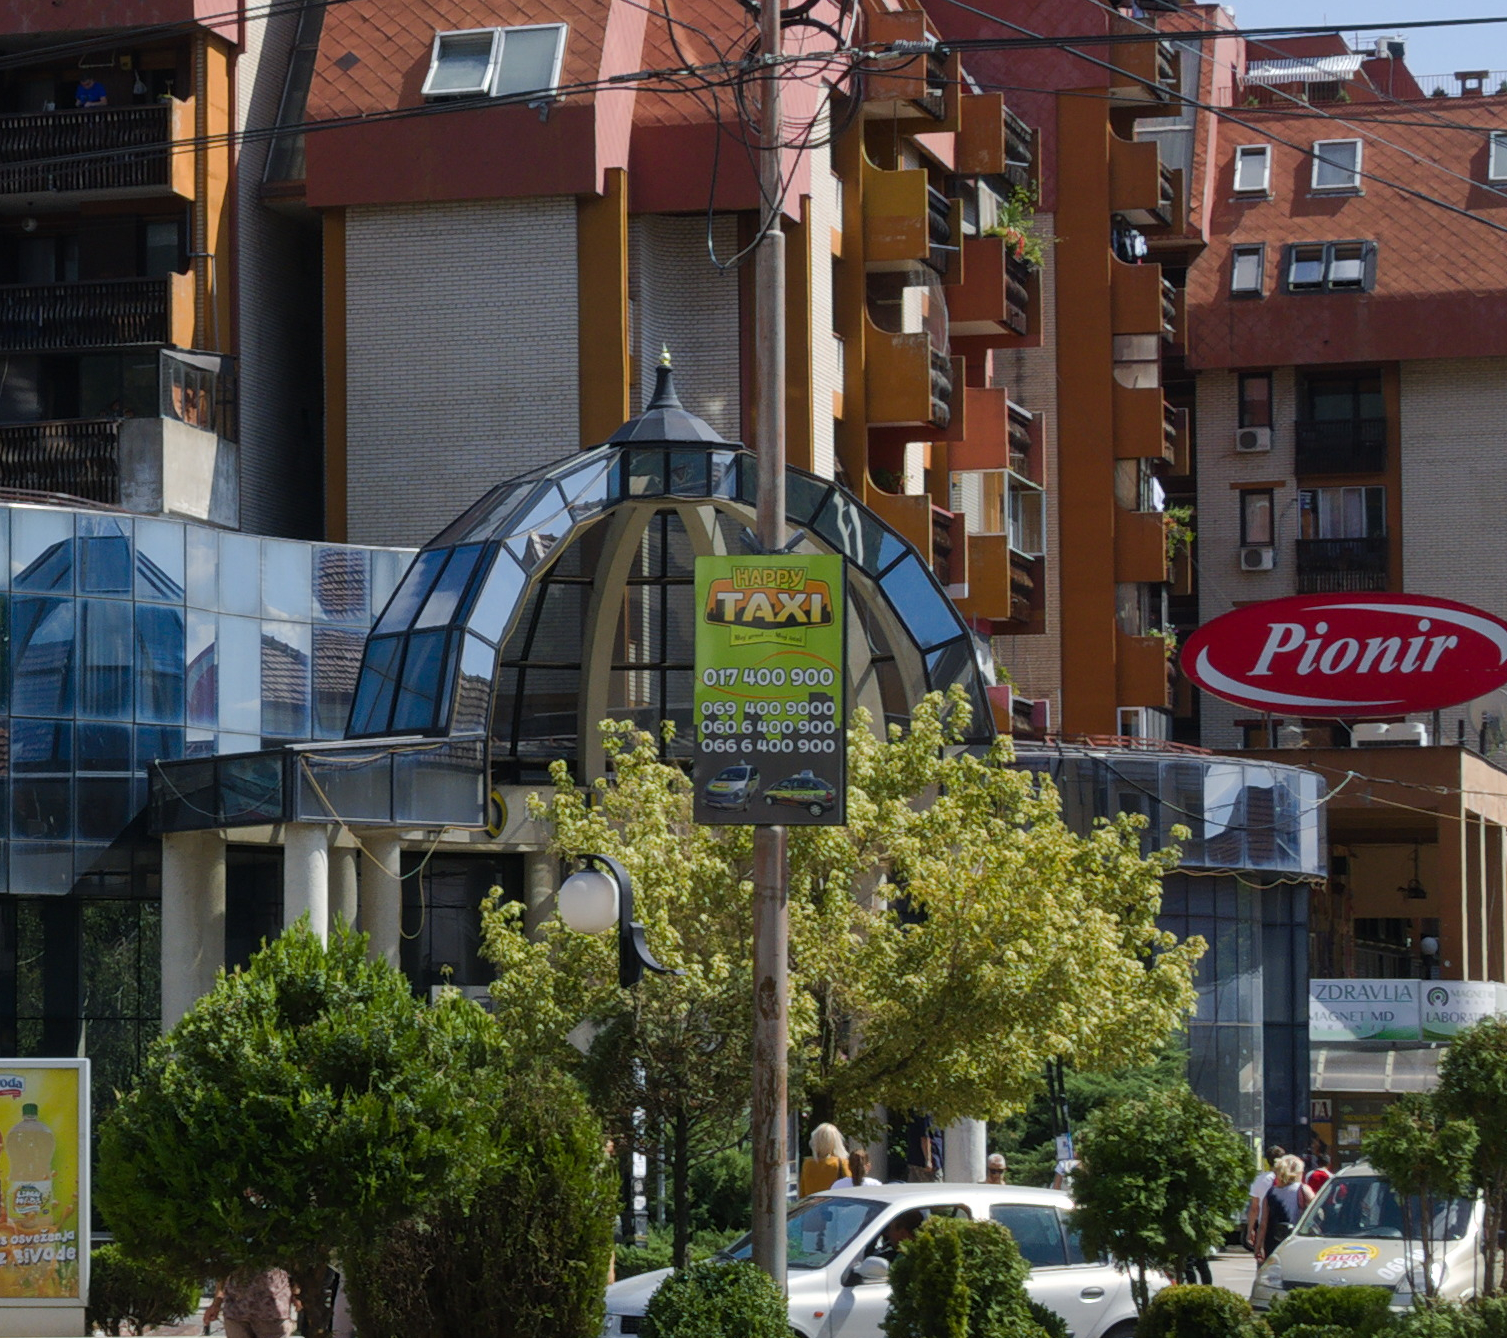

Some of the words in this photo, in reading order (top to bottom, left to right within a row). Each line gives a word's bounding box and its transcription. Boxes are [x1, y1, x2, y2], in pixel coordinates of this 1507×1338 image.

[736, 568, 805, 588] HAPPY
[716, 592, 823, 623] TAXI
[1246, 619, 1459, 676] Pionir
[703, 667, 739, 687] 017
[742, 667, 786, 687] 400
[790, 667, 834, 687] 900
[701, 701, 737, 716] 069
[744, 701, 782, 716] 400
[785, 701, 835, 716] 9000
[701, 720, 737, 735] 060
[741, 720, 754, 735] 6
[756, 720, 794, 735] 400
[797, 720, 836, 735] 900
[701, 738, 737, 753] 066
[740, 738, 754, 753] 6
[756, 738, 794, 753] 400
[797, 738, 836, 753] 900
[1371, 1011, 1395, 1022] MD
